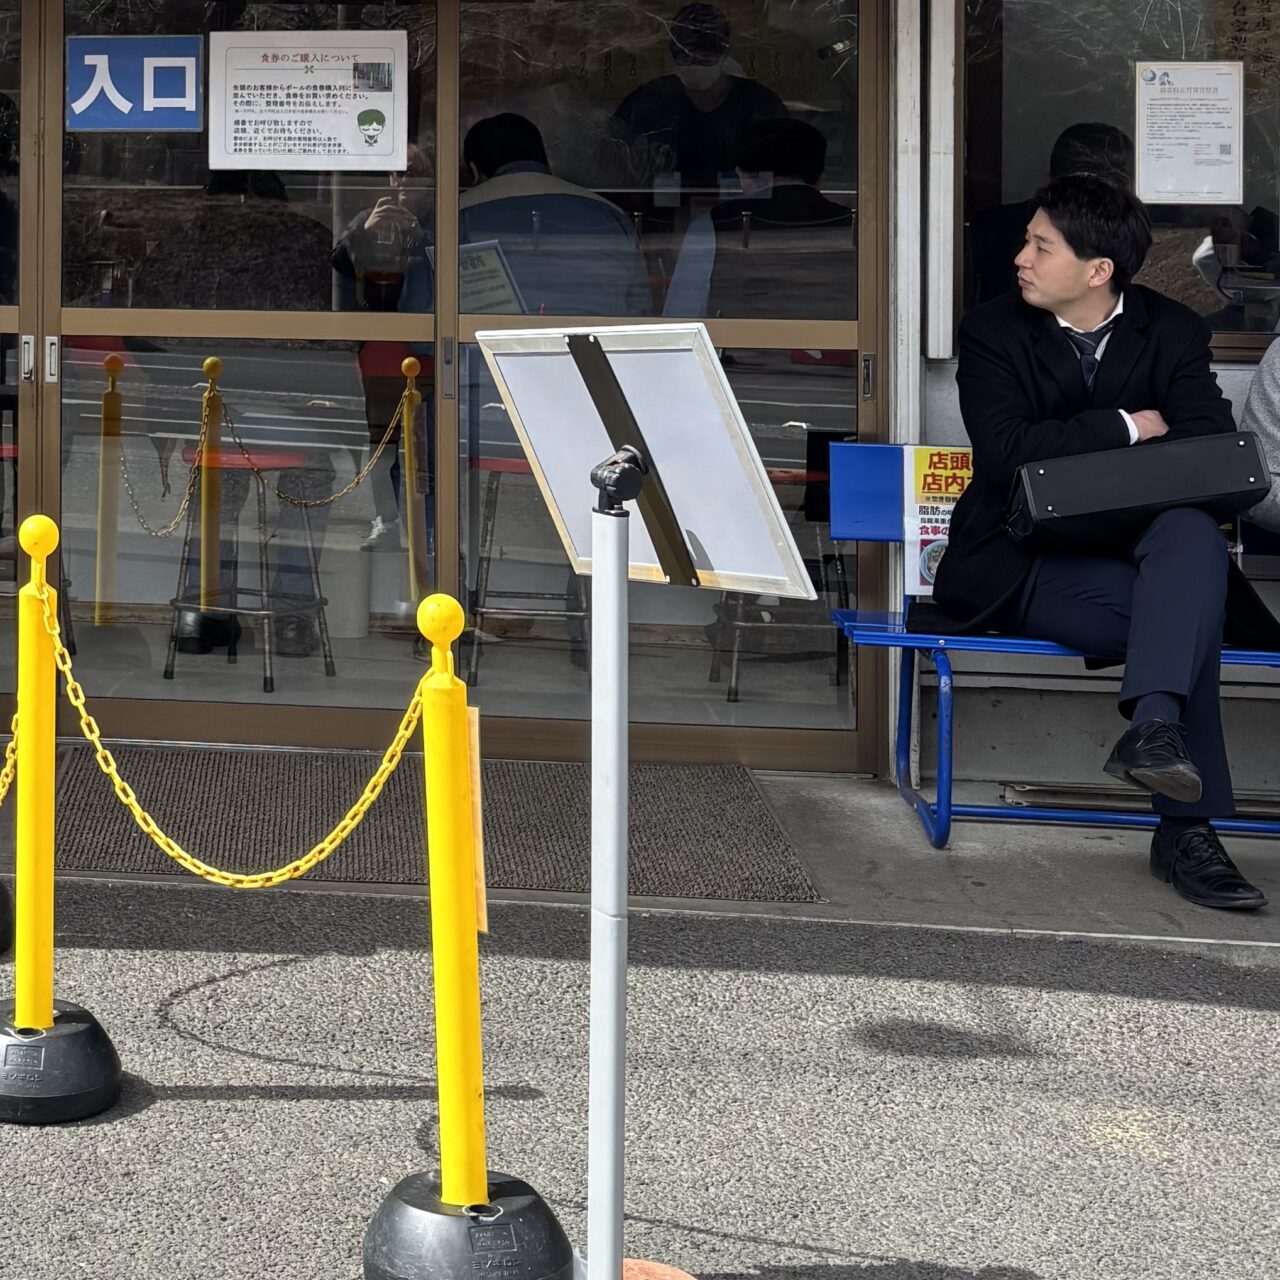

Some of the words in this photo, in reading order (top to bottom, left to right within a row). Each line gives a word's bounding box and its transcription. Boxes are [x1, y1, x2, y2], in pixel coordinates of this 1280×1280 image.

[261, 53, 360, 64] 食券のご購入について
[70, 54, 197, 116] 入口
